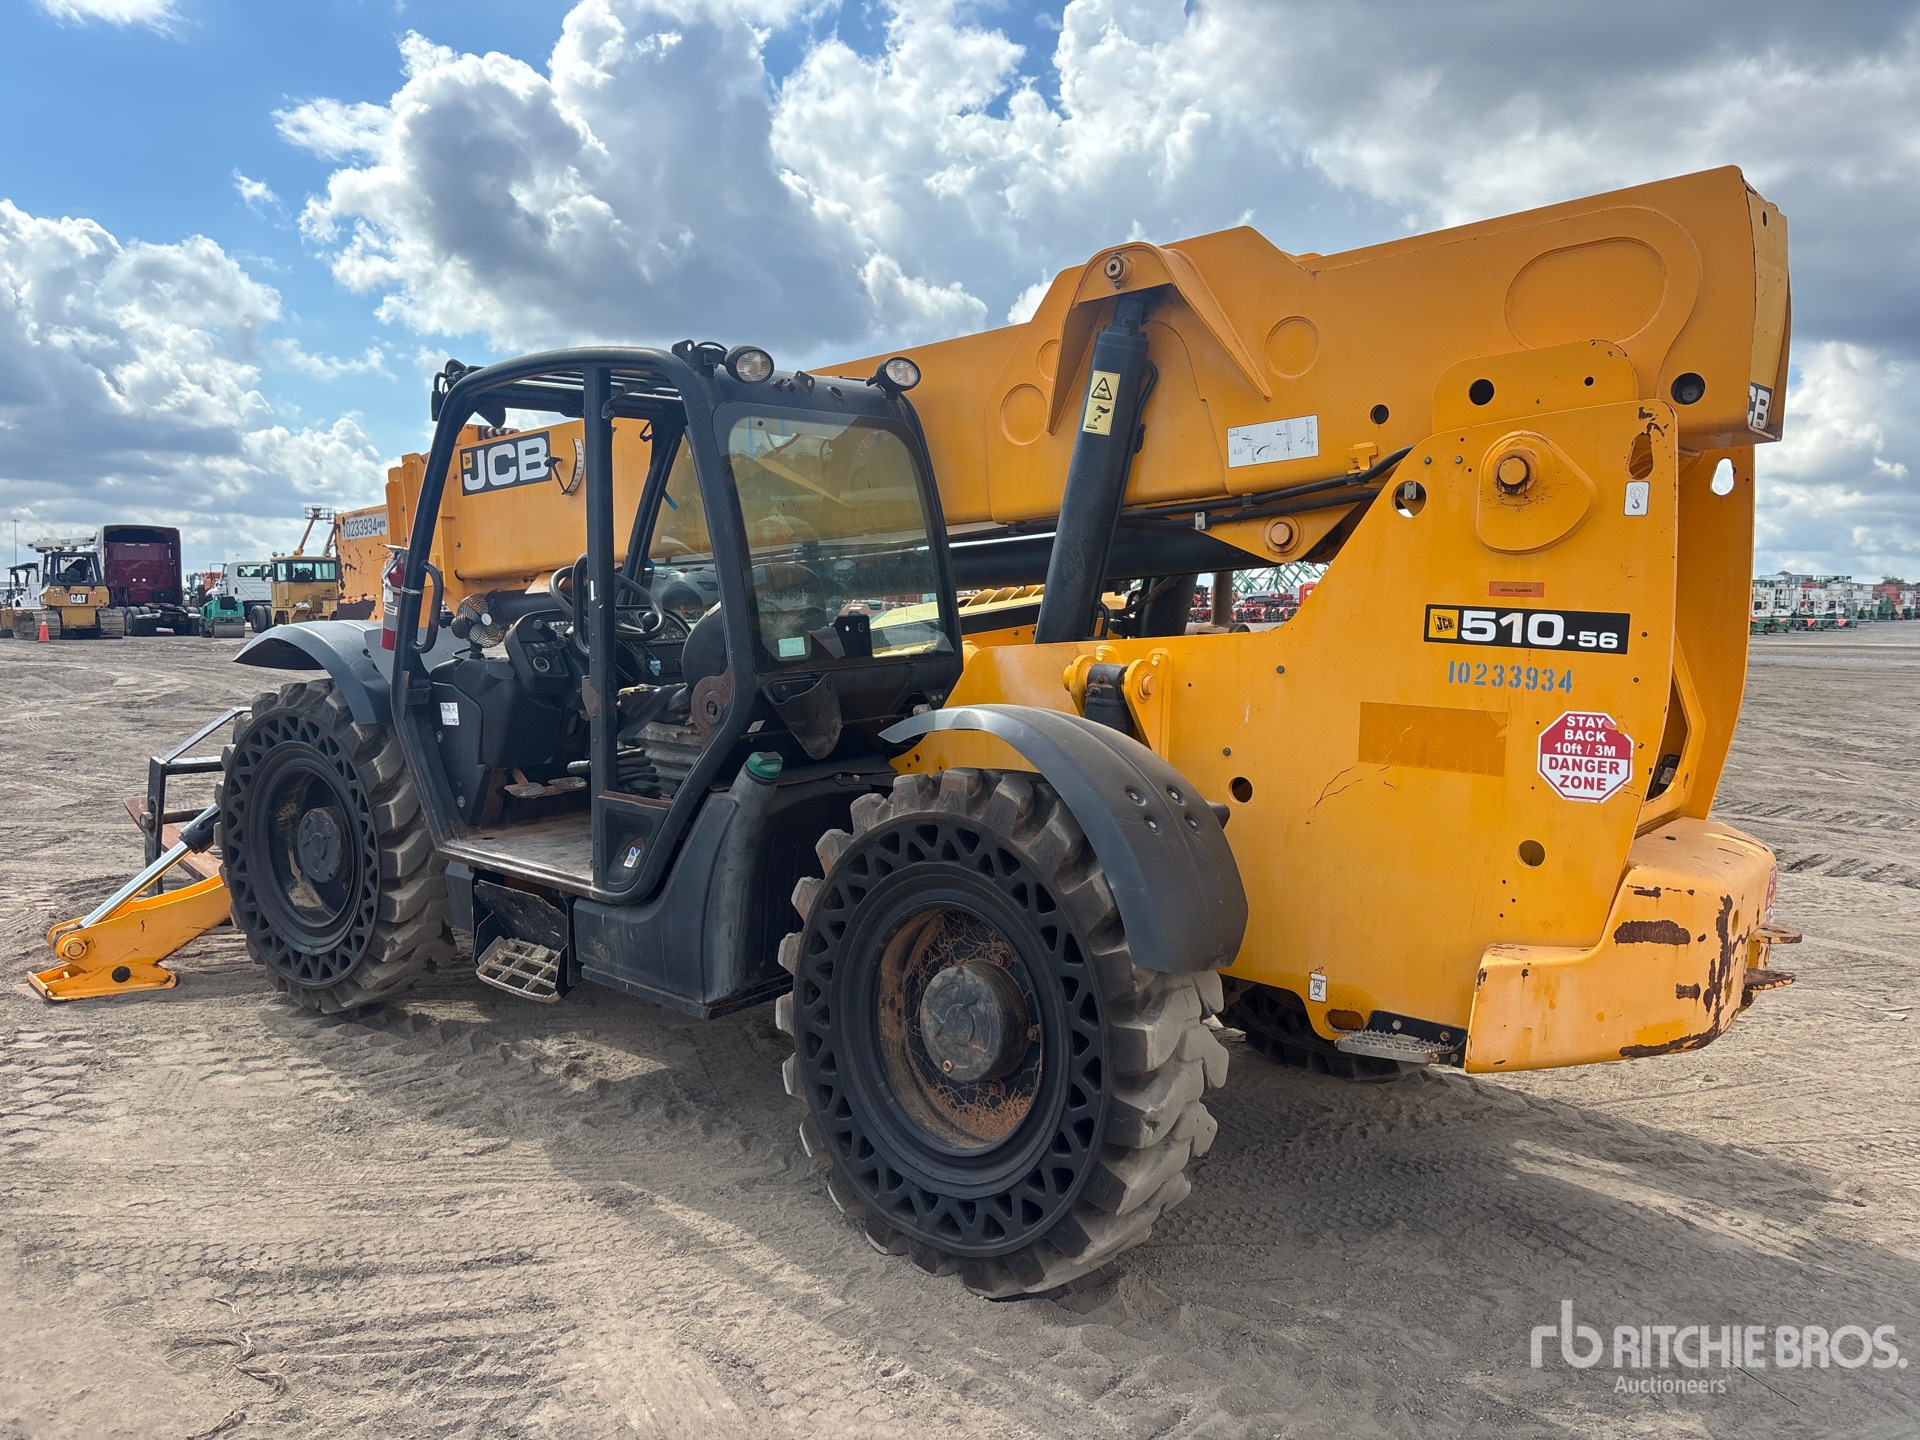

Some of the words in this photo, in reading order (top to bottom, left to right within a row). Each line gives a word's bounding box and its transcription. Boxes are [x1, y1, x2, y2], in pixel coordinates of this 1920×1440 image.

[463, 437, 549, 491] JCB
[70, 594, 86, 604] CAT
[1436, 616, 1454, 631] JCB
[1461, 610, 1619, 649] 510-56
[1448, 660, 1573, 694] 10233934
[1567, 716, 1606, 729] STAY
[1564, 729, 1607, 742] BACK
[1555, 742, 1582, 755] 10ft
[1595, 744, 1616, 757] 3M
[1548, 756, 1620, 775] DANGER
[1559, 774, 1607, 792] ZONE
